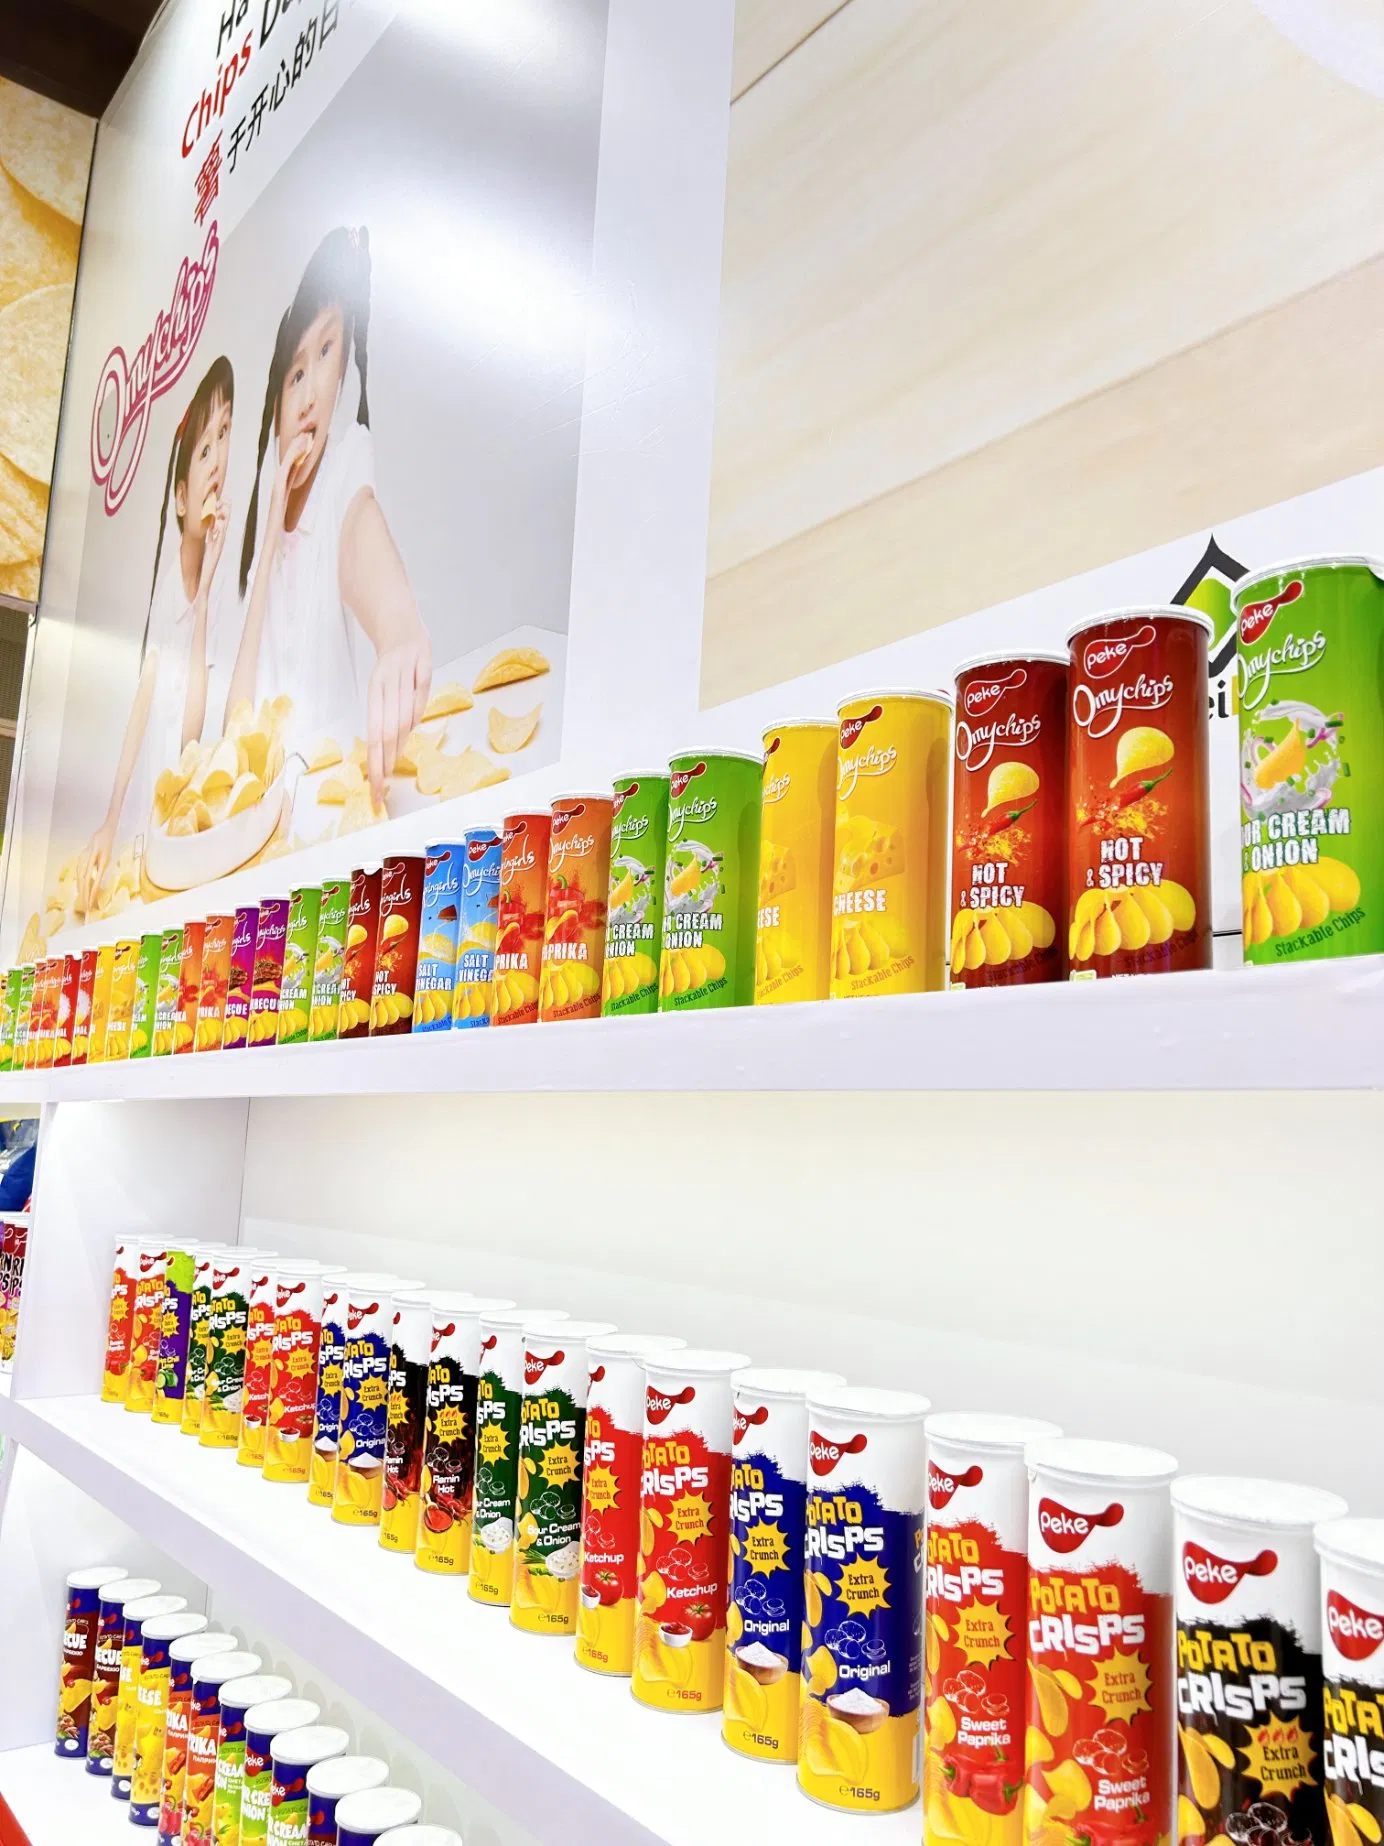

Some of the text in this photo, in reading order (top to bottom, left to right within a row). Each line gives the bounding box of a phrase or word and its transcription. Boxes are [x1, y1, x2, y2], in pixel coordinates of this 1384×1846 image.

[182, 29, 254, 159] Chips
[1073, 673, 1174, 738] Omychips
[956, 713, 1041, 772] Omychips
[1268, 808, 1351, 840] CREAM
[1100, 837, 1144, 863] HOT
[1252, 838, 1319, 872] ONION
[972, 862, 1009, 885] HOT
[1086, 862, 1164, 889] & SPICY
[834, 889, 887, 916] CHEESE
[960, 885, 1025, 909] & SPICY
[676, 912, 723, 930] CREAM
[613, 923, 654, 940] CREAM
[1275, 907, 1366, 957] Stackable Chips
[665, 931, 703, 950] ONION
[464, 954, 488, 967] SALT
[376, 970, 389, 982] HOT
[419, 964, 439, 977] SALT
[781, 964, 804, 986] Chips
[851, 955, 915, 991] Stackable Chips
[372, 983, 397, 996] SPICY
[674, 976, 728, 1006] Stackable Chips
[388, 1465, 399, 1473] Hot
[548, 1456, 568, 1465] Extra
[546, 1466, 572, 1478] Crunch
[438, 1485, 455, 1494] Hot
[592, 1479, 607, 1488] Extra
[484, 1497, 510, 1508] Cream
[590, 1489, 611, 1500] Crunch
[479, 1509, 501, 1518] Onion
[677, 1507, 700, 1518] Extra
[527, 1522, 581, 1534] Sour Cream
[675, 1518, 704, 1531] Crunch
[1040, 1511, 1089, 1535] Peke
[536, 1535, 571, 1546] & Onion
[752, 1536, 774, 1547] Extra
[584, 1552, 624, 1565] Ketchup
[750, 1548, 779, 1560] Crunch
[1184, 1556, 1238, 1584] Peke
[848, 1573, 874, 1586] Extra
[666, 1583, 718, 1599] Ketchup
[846, 1587, 880, 1600] Crunch
[1030, 1577, 1121, 1614] POTATO
[744, 1619, 789, 1636] Original
[965, 1619, 994, 1632] Extra
[1328, 1605, 1384, 1639] Peke
[964, 1635, 1000, 1649] Crunch
[1028, 1613, 1146, 1655] CRISPS
[1177, 1628, 1278, 1674] POTATO
[839, 1660, 891, 1681] Original
[1104, 1672, 1136, 1686] Extra
[1102, 1689, 1141, 1704] Crunch
[1178, 1672, 1307, 1720] CRISPS
[961, 1716, 1007, 1732] Sweet
[958, 1730, 1011, 1749] Paprika
[1263, 1745, 1300, 1761] Extra
[1260, 1763, 1306, 1781] Crunch
[1098, 1776, 1146, 1795] Sweet
[1094, 1791, 1151, 1812] Paprika
